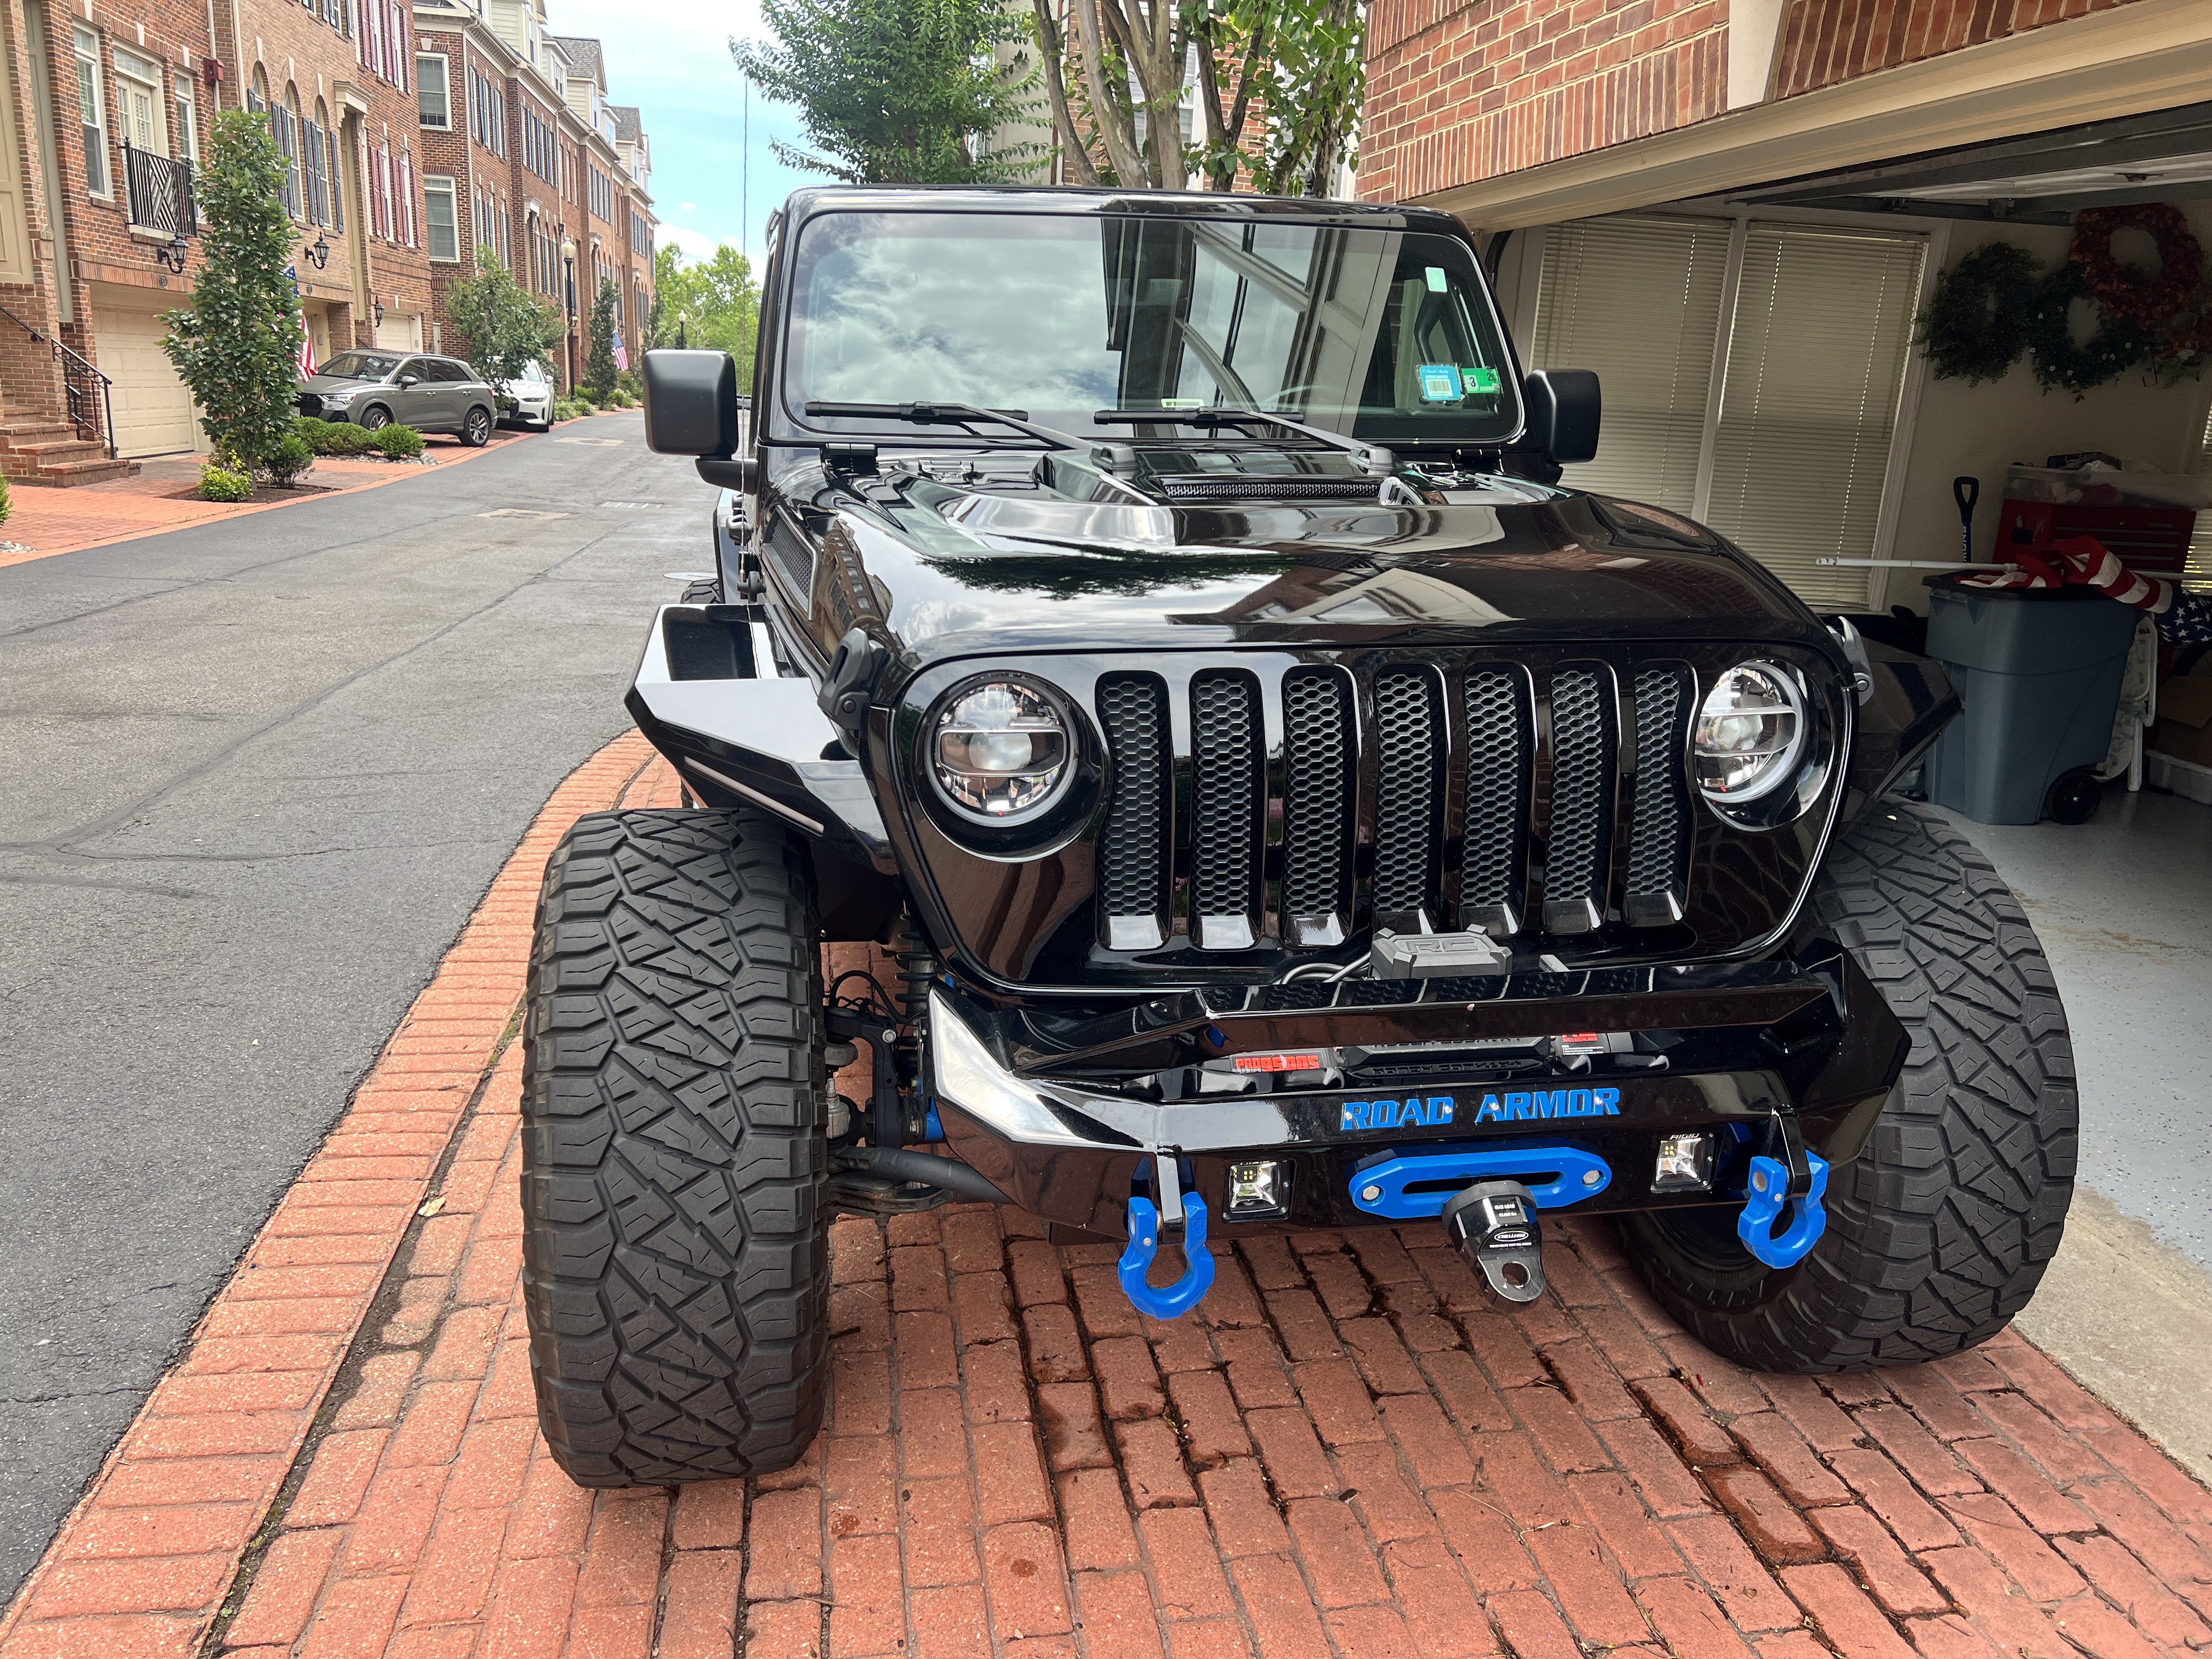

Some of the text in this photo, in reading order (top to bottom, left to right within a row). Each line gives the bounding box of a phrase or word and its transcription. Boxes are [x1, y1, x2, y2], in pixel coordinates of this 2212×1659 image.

[1469, 376, 1476, 387] 3
[1406, 938, 1478, 953] RC
[1341, 1087, 1621, 1131] ROAD ARMOR
